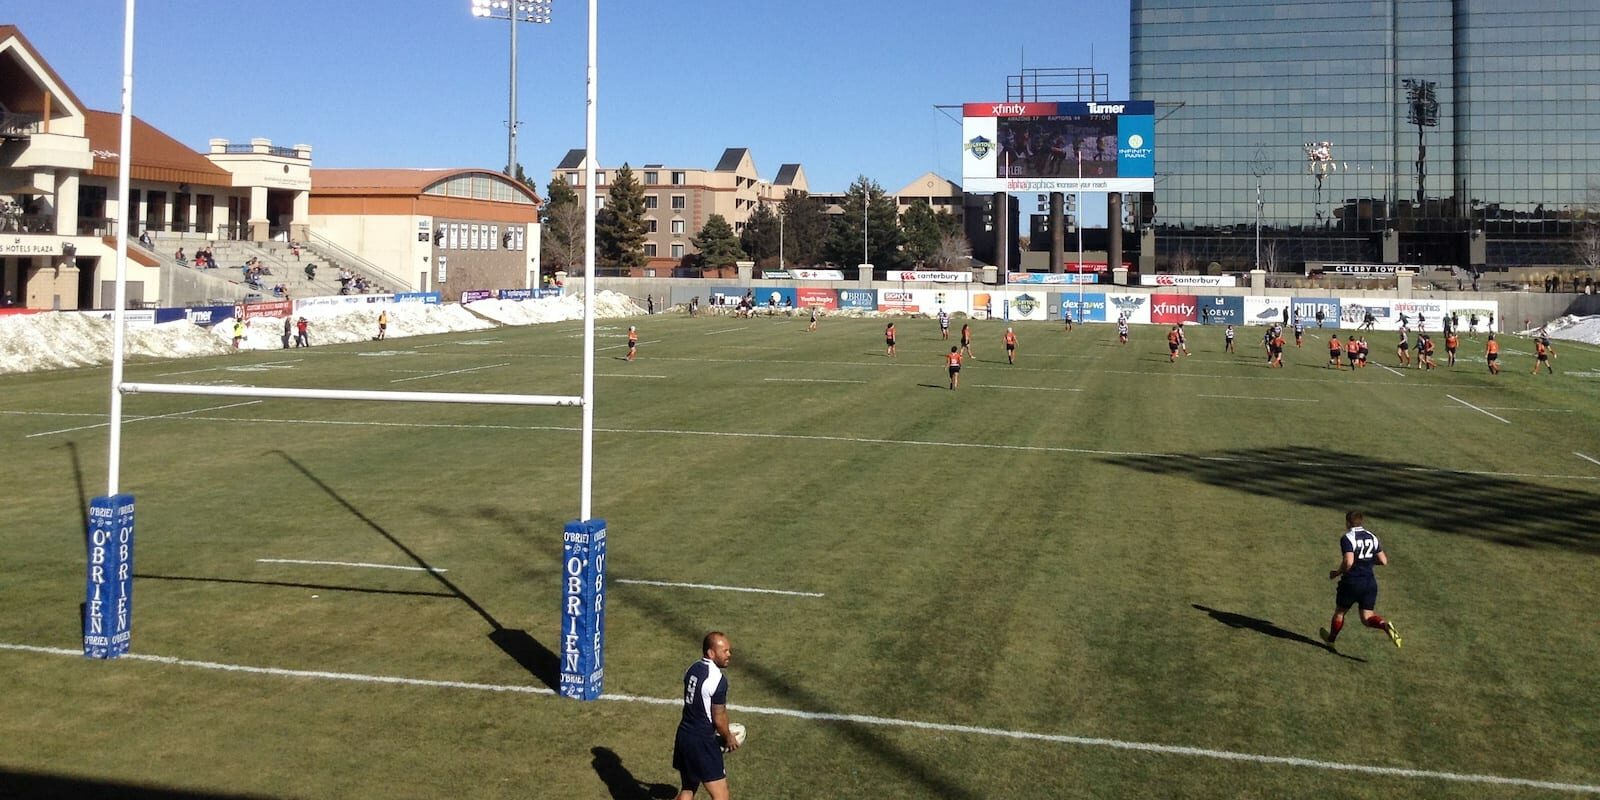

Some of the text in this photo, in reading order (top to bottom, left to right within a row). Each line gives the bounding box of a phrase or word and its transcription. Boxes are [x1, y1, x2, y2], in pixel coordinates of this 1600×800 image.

[992, 104, 1026, 116] xfinity
[1087, 103, 1125, 114] Turner
[1008, 179, 1055, 190] alphagraphics
[6, 245, 31, 253] HOTELS
[33, 245, 53, 253] PLAZA
[1335, 265, 1371, 273] CHERRY
[917, 272, 959, 281] canterbury
[1174, 277, 1221, 285] canterbury
[1153, 303, 1195, 317] xfinity
[1208, 308, 1235, 317] OEWS
[1395, 303, 1441, 313] alphagraphics
[185, 309, 213, 323] Turner
[91, 529, 111, 633] O'BRIEN
[566, 557, 588, 672] O'BRIEN
